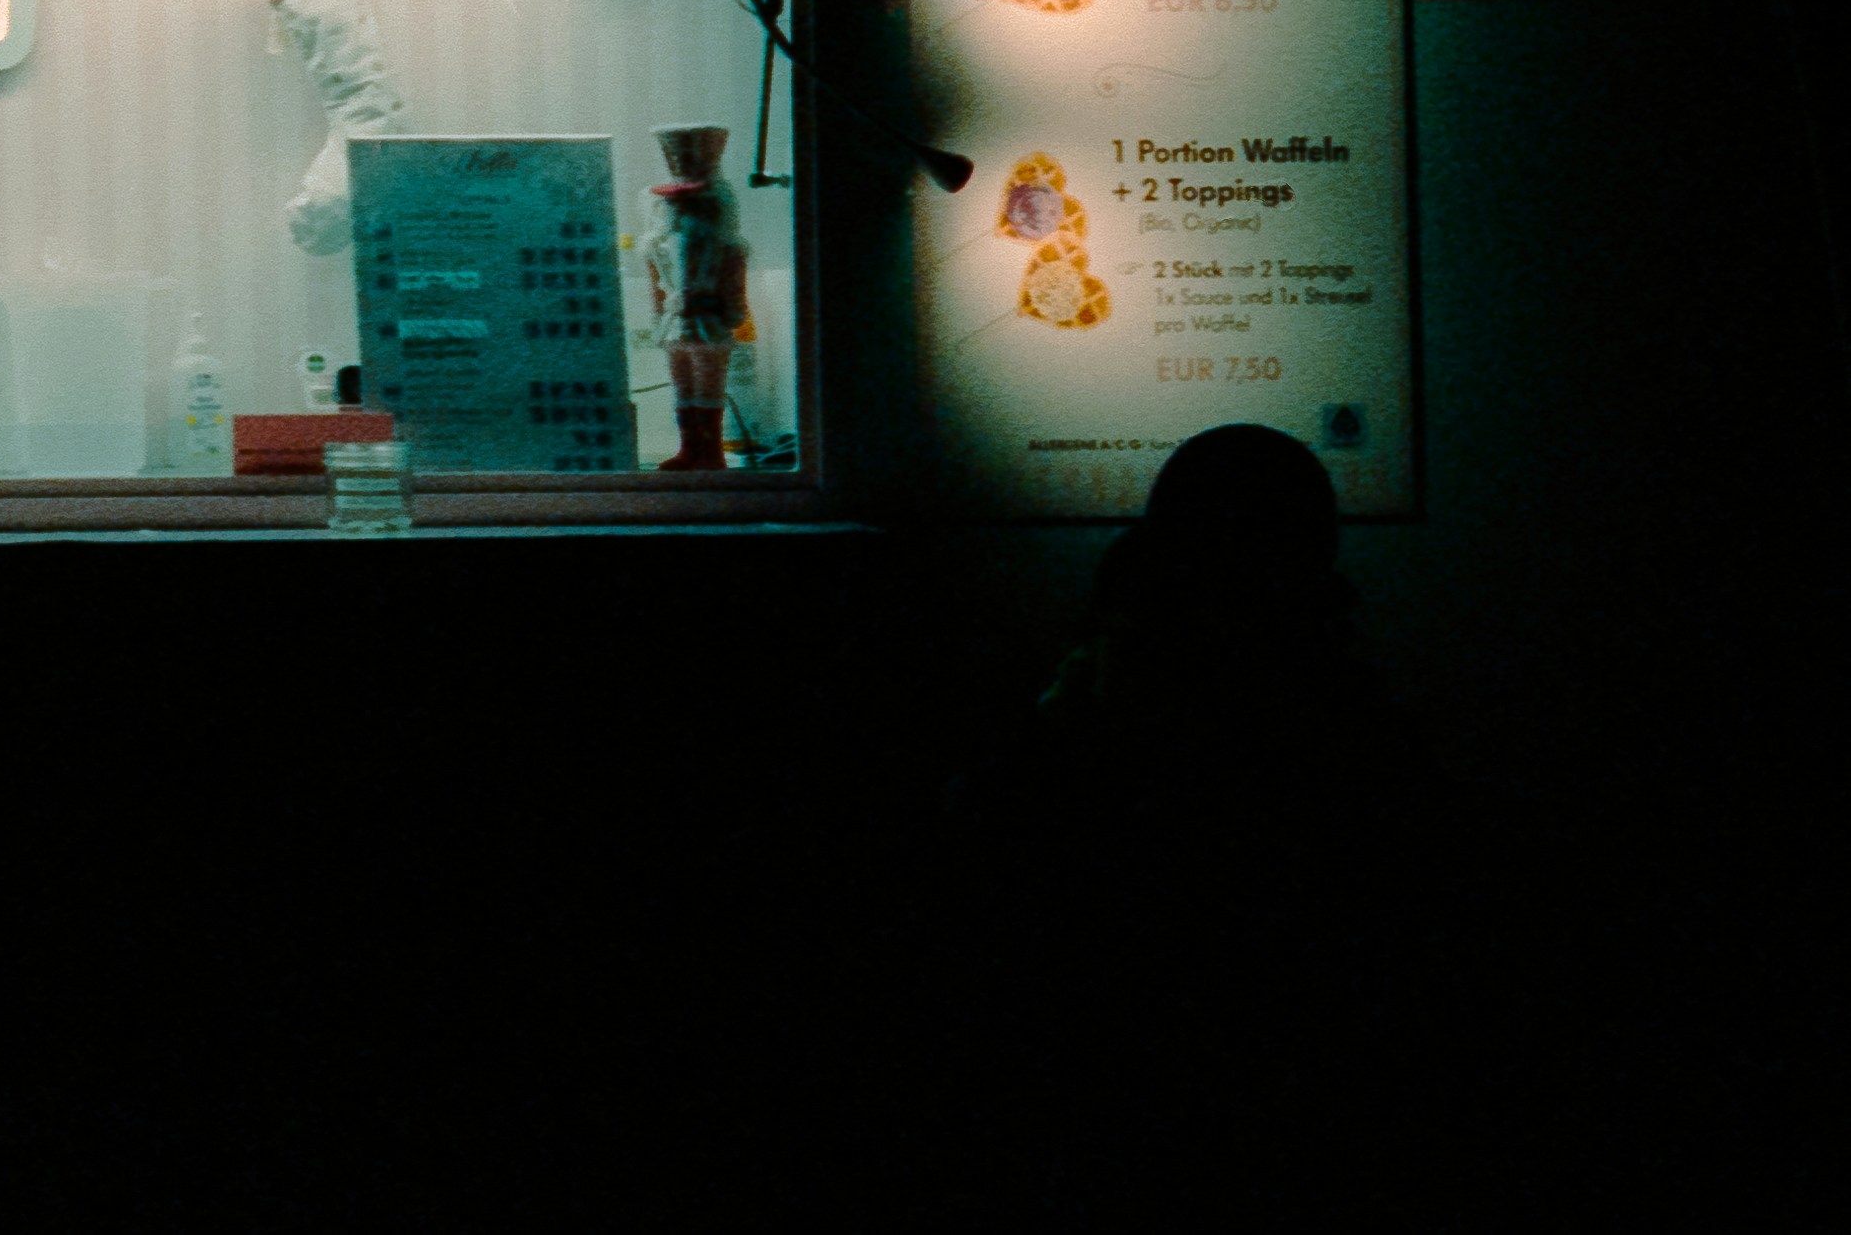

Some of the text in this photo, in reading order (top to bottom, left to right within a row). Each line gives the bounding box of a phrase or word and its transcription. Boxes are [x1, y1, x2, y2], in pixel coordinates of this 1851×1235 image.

[1112, 136, 1350, 163] 1 Portion Waffeln
[1142, 178, 1159, 202] 2
[1169, 177, 1294, 207] Toppings
[1152, 260, 1167, 278] 2
[1172, 259, 1223, 278] Stück
[1260, 260, 1273, 278] 2
[1180, 287, 1234, 305] Sauce
[1240, 286, 1274, 305] und
[1155, 313, 1251, 336] pro Waffel
[1156, 356, 1283, 384] EUR 7,50
